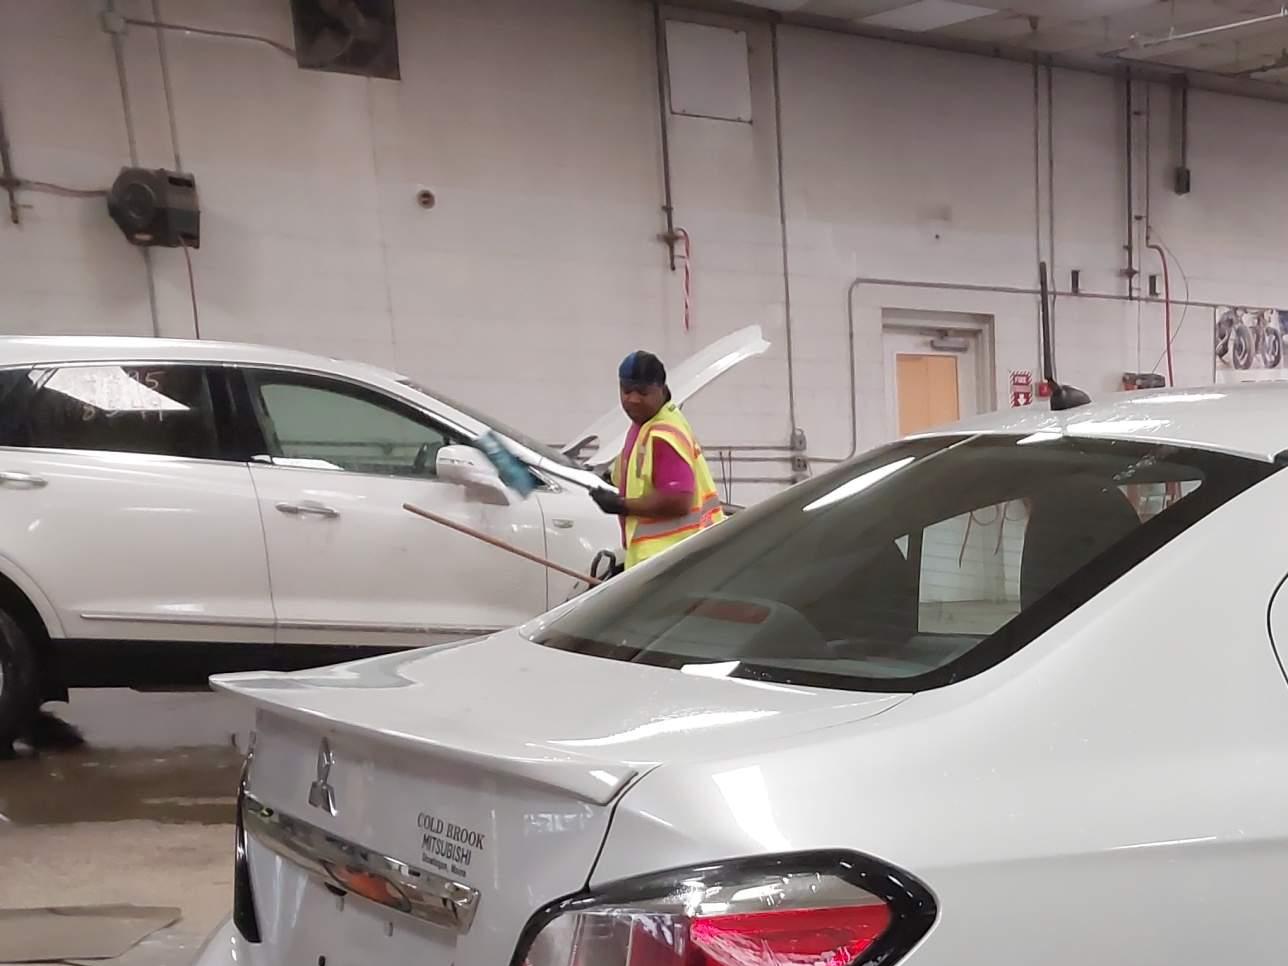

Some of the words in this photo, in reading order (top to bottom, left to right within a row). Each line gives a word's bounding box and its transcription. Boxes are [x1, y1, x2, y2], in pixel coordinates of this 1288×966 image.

[417, 812, 444, 834] COLD
[446, 823, 485, 850] BROOK
[422, 833, 472, 866] MITSUBISHI
